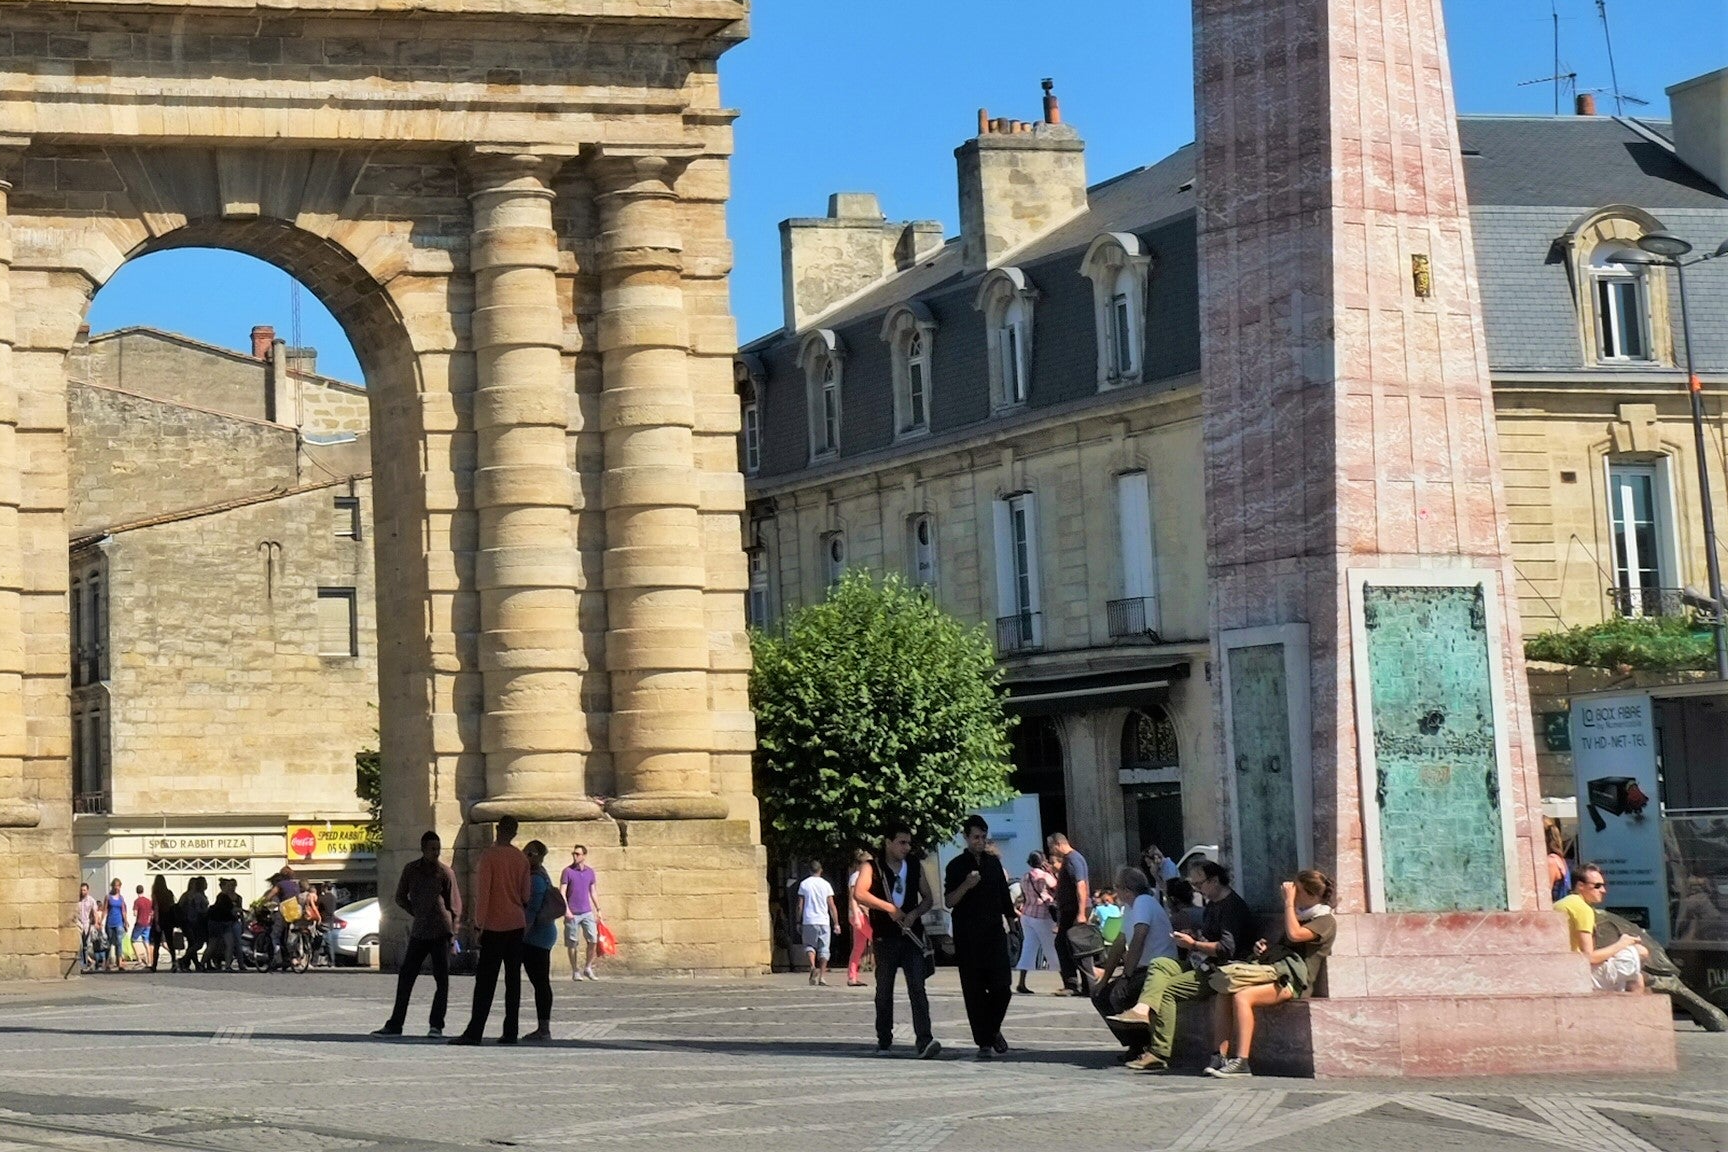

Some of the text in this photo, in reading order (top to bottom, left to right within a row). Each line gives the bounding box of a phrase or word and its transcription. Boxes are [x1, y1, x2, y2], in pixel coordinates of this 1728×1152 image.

[318, 831, 338, 841] SPEED
[149, 838, 247, 849] SPED RABBIT PIZZA
[1707, 968, 1728, 987] nu
